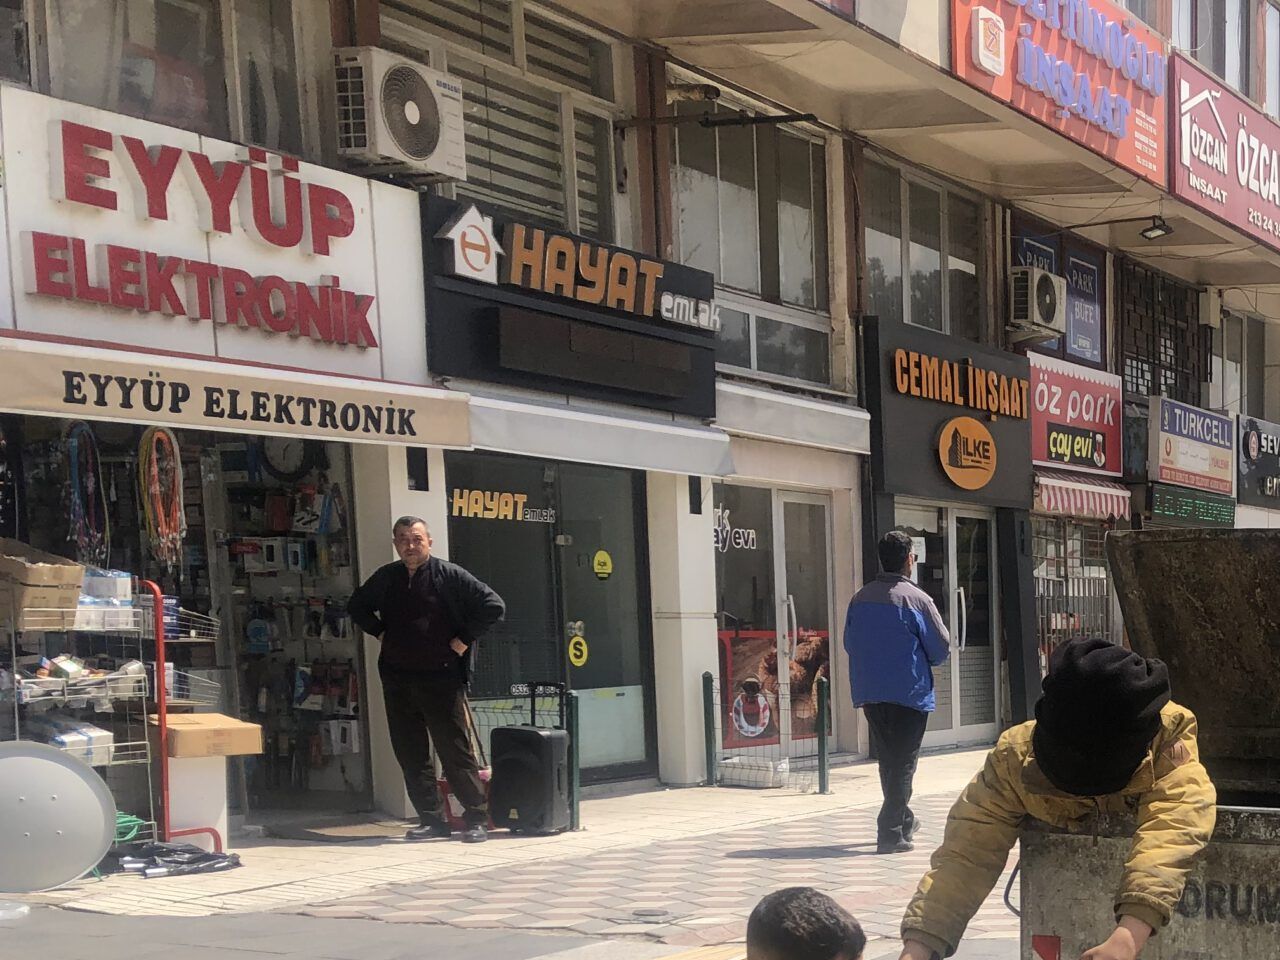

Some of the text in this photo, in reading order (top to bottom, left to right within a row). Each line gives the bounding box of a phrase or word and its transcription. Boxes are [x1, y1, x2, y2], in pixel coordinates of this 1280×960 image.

[1016, 23, 1131, 139] İNŞAAT
[1191, 115, 1228, 175] ÖZCAN
[54, 120, 355, 257] EYYÜP
[1189, 168, 1228, 204] İNŞAAT
[1248, 207, 1262, 227] 213
[1263, 215, 1273, 233] 24
[506, 222, 665, 317] HAYAT
[1026, 252, 1050, 274] PARK
[26, 231, 378, 349] ELEKTRONİK
[1072, 269, 1094, 295] PARK
[62, 371, 416, 436] EYYÜP ELEKTRONİK
[894, 348, 1030, 422] CEMAL İNŞAAT
[1066, 390, 1116, 426] park
[1174, 408, 1231, 447] TURKCELL
[1049, 431, 1093, 462] çay evi
[452, 488, 527, 521] HAYAT
[732, 528, 757, 549] evi
